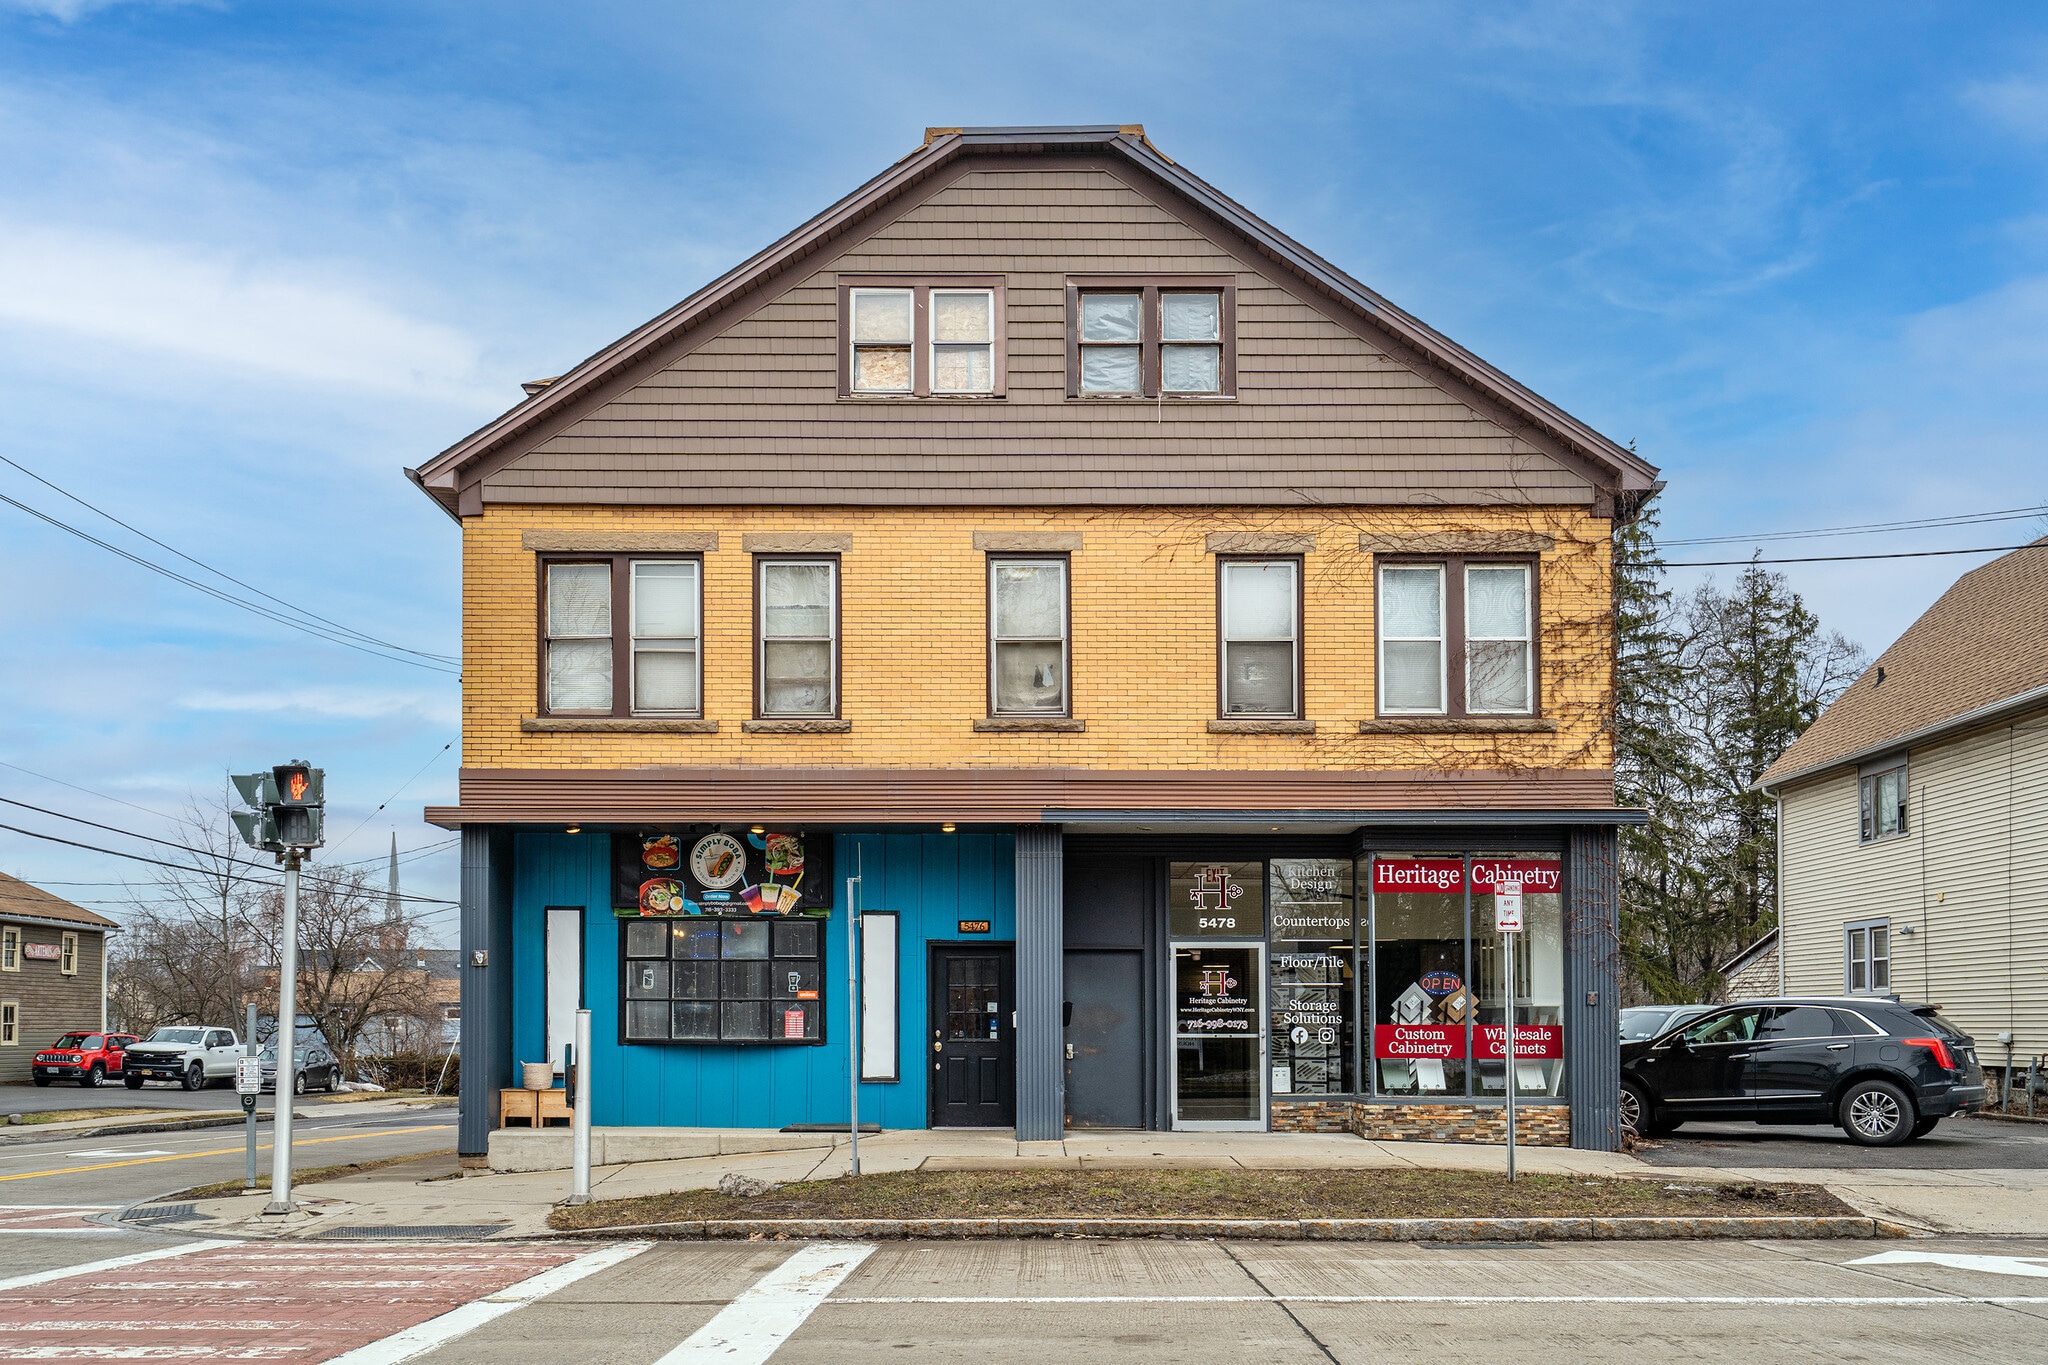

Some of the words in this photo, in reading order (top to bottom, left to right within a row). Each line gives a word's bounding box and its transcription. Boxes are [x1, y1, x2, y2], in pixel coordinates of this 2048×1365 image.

[696, 838, 722, 860] SIMPLY
[723, 839, 742, 859] BOBA
[1288, 865, 1335, 877] Kitchen
[1377, 863, 1460, 889] Heritage
[1471, 863, 1561, 889] Cabinetry
[1291, 878, 1333, 892] Design
[1503, 899, 1514, 907] ANY
[964, 922, 985, 931] 5476
[1198, 917, 1236, 929] 5478
[1273, 915, 1350, 930] Countertops
[1280, 955, 1344, 970] Floor/Tile
[1421, 977, 1461, 990] OPEN
[1189, 997, 1216, 1005] Heritage
[1217, 997, 1248, 1005] Cabinetry
[1289, 999, 1337, 1013] Storage
[1187, 1018, 1249, 1030] 716-998-0173
[1283, 1012, 1343, 1024] Solutions
[1395, 1027, 1445, 1041] Custom
[1484, 1027, 1552, 1041] Whlesale
[1388, 1041, 1453, 1057] Cabinetry
[1489, 1041, 1547, 1054] Cainets
